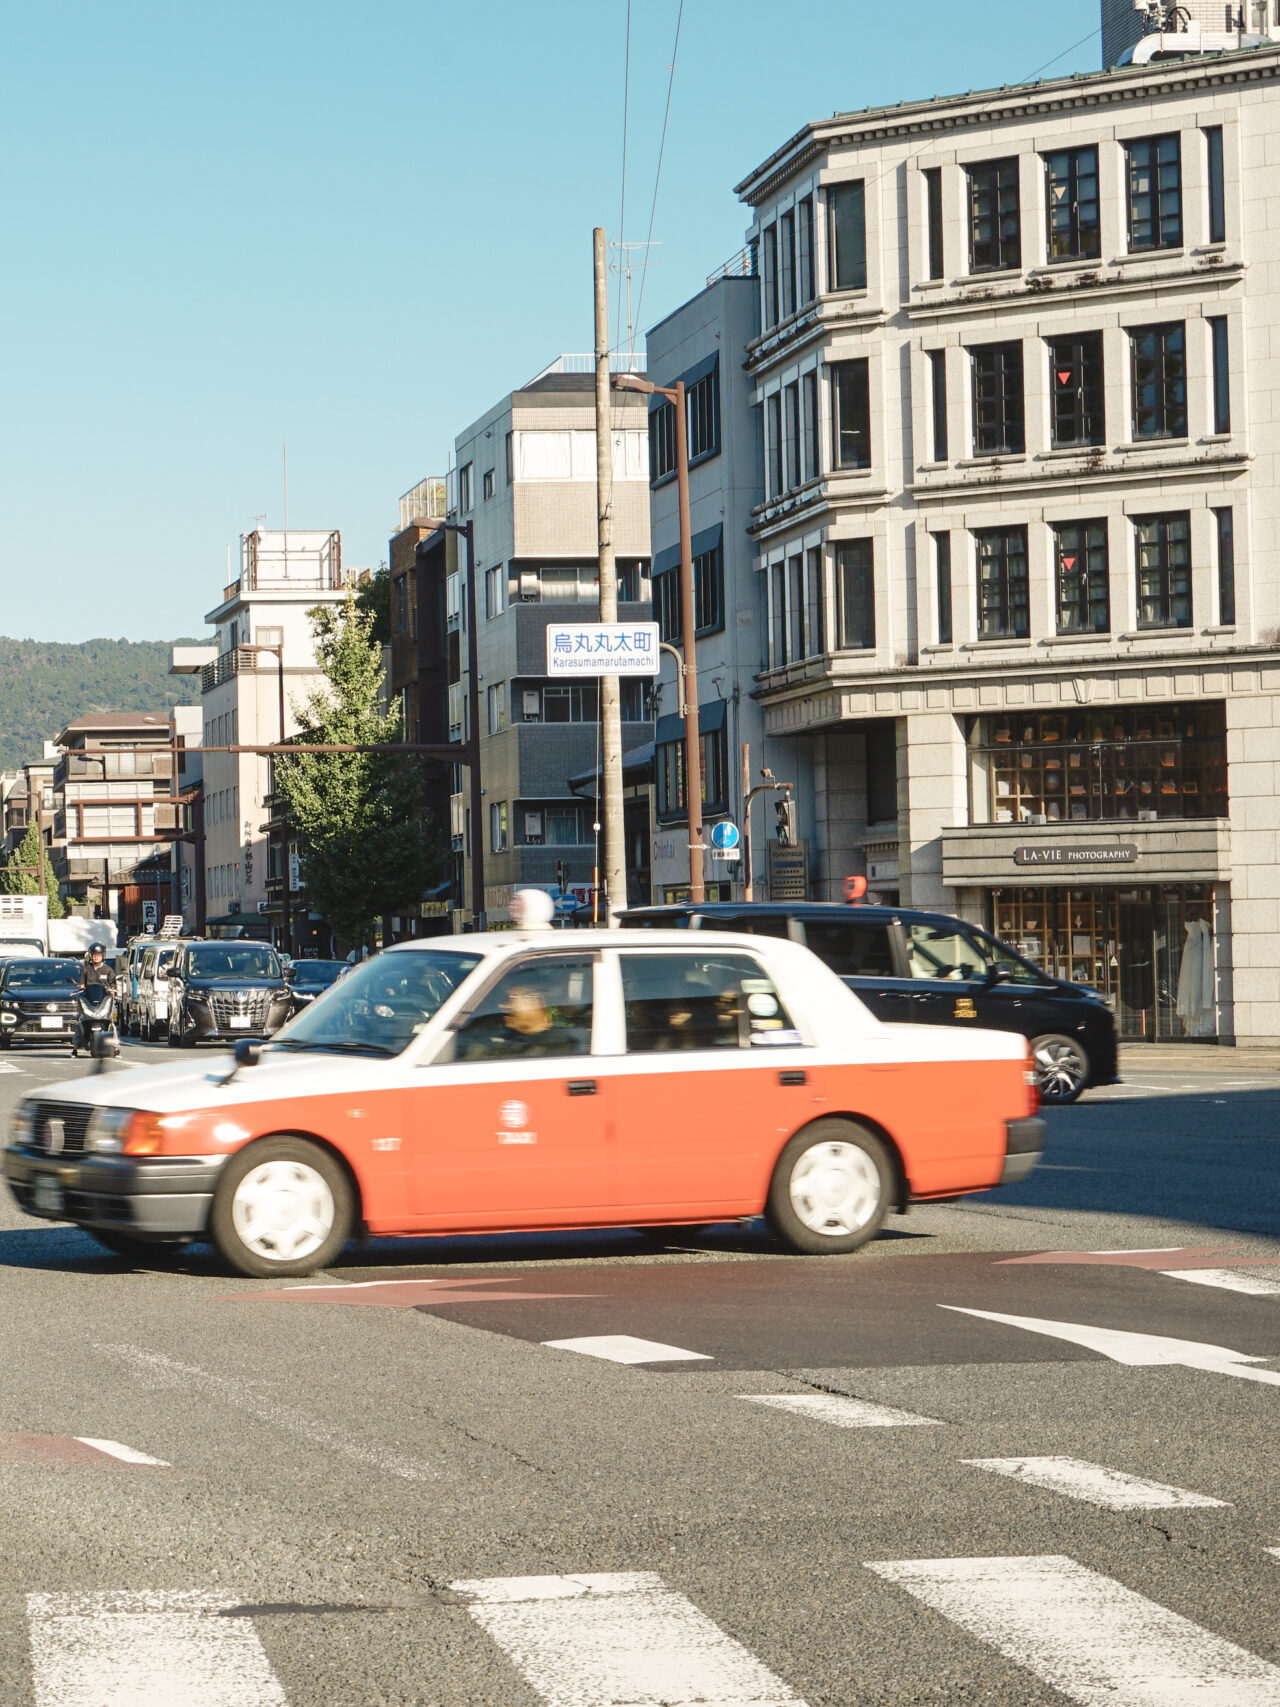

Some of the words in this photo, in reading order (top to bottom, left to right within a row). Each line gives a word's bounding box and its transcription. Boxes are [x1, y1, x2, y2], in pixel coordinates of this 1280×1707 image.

[554, 631, 652, 653] 烏丸丸太町
[553, 656, 654, 668] Karasumamarutamachi
[1023, 849, 1062, 861] LA-VIE
[1068, 850, 1131, 860] PHOTOGRAPHY
